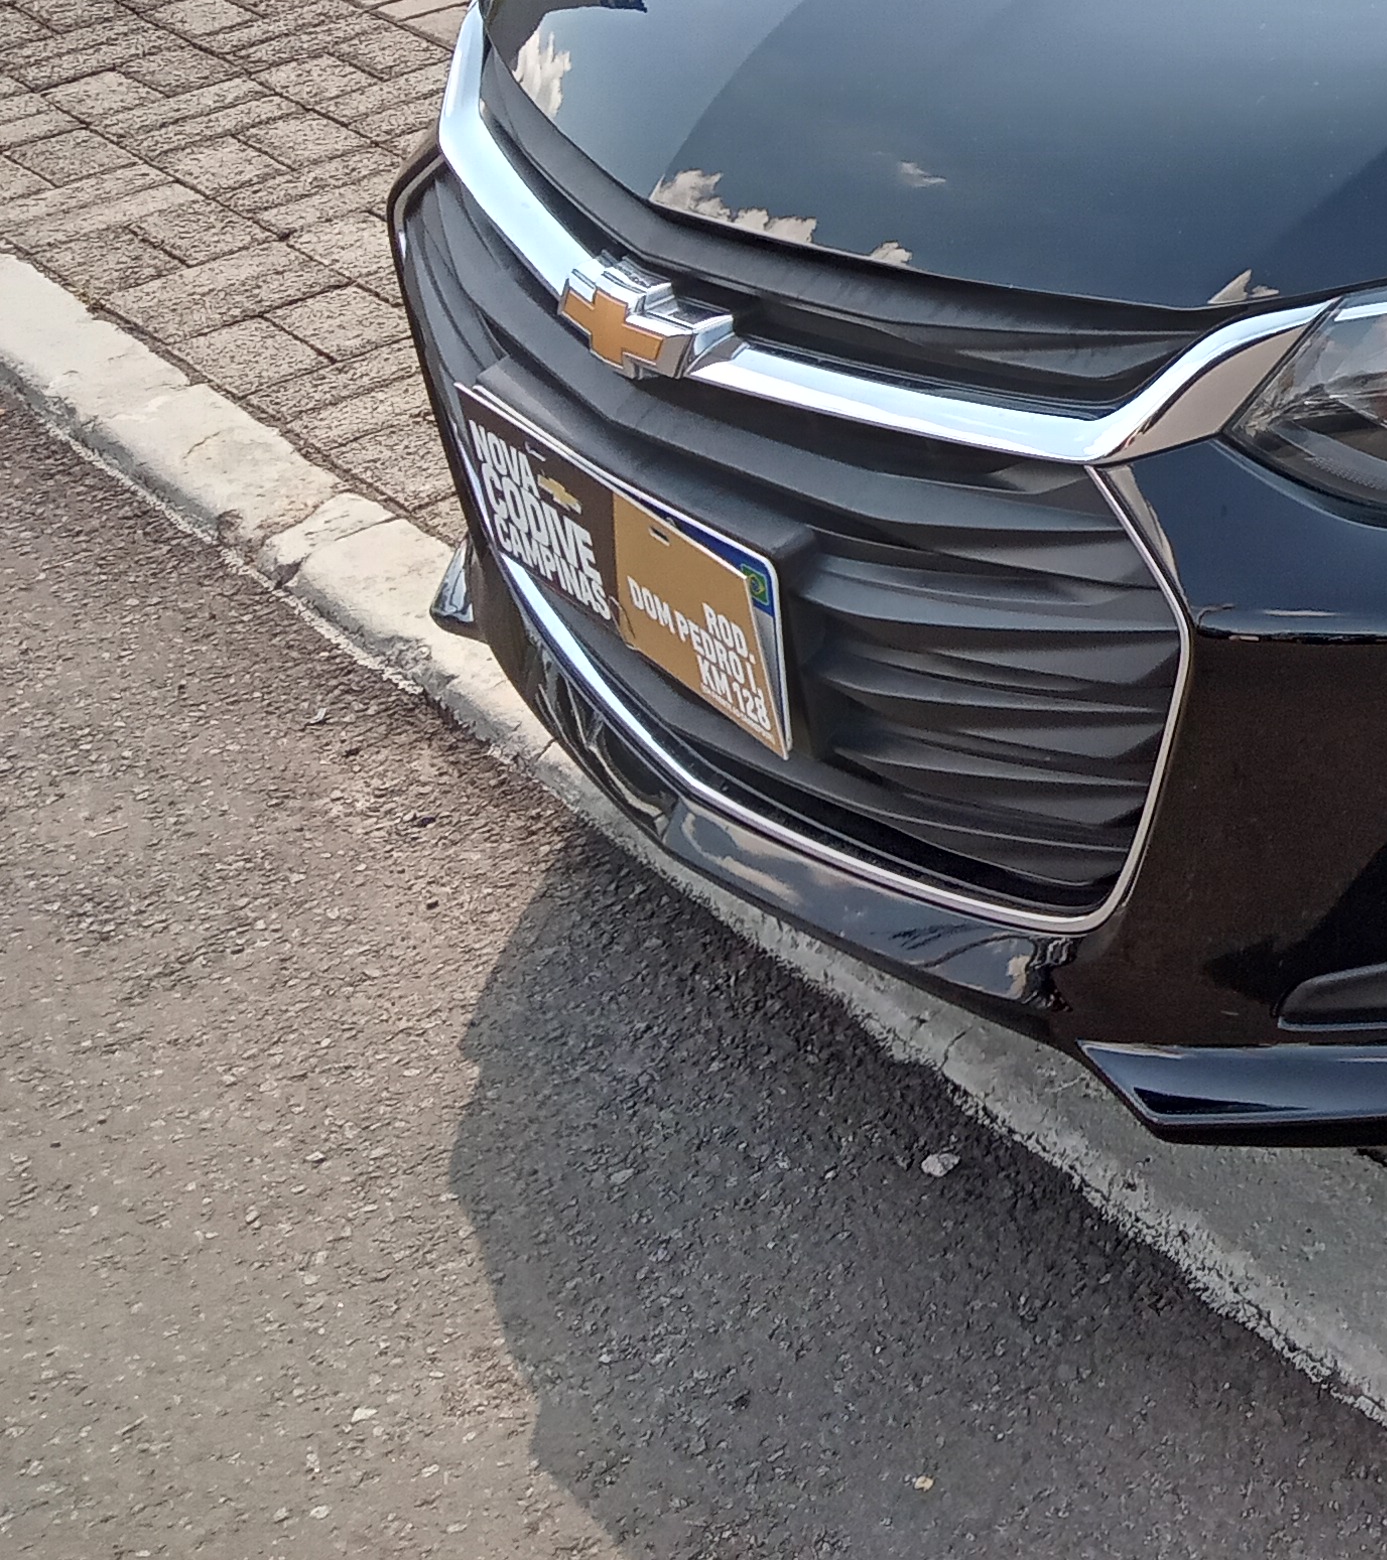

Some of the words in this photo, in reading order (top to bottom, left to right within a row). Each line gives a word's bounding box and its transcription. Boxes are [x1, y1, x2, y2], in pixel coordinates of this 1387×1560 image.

[469, 420, 539, 495] NOVA
[481, 463, 602, 582] CODIVE
[494, 514, 611, 620] CAMPINAS
[627, 575, 675, 636] DOM
[677, 610, 745, 679] PEDRO
[702, 603, 755, 664] ROD.
[699, 654, 733, 705] KM
[736, 684, 771, 731] 128
